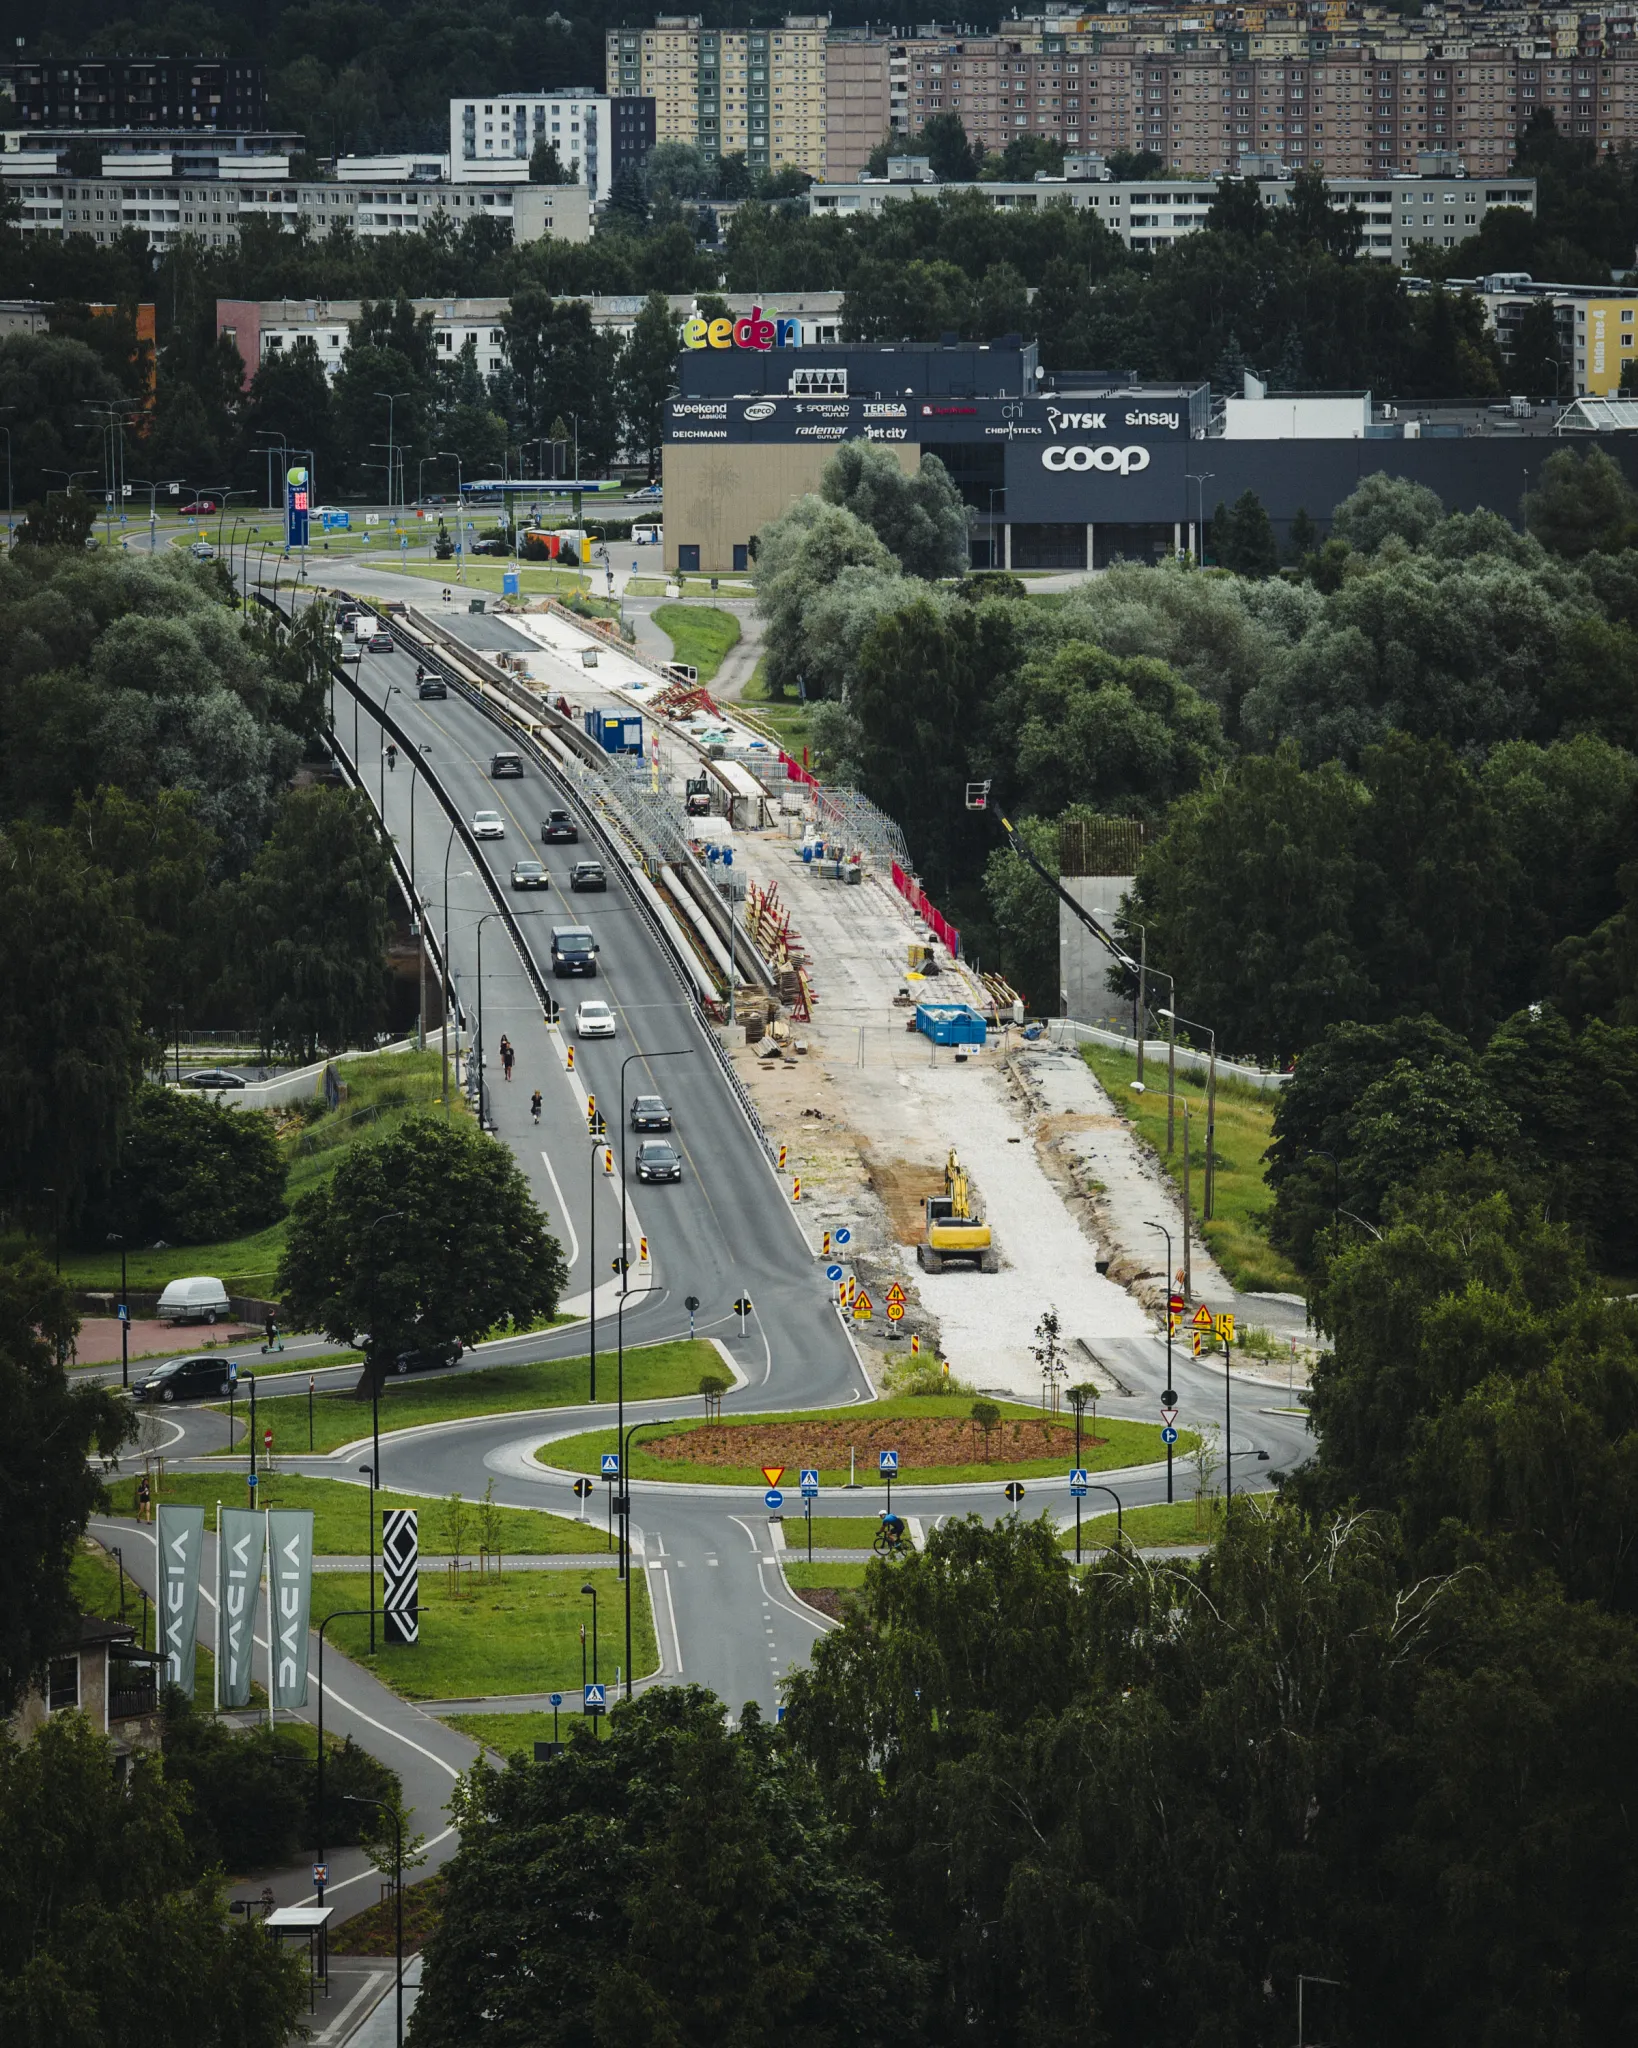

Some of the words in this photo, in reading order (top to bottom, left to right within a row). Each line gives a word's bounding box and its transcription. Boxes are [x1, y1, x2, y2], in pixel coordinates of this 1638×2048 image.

[683, 305, 802, 350] eeden
[673, 403, 727, 413] Weekend
[806, 404, 849, 412] SPORTLAND
[863, 403, 907, 412] TERESA
[1002, 402, 1023, 418] chi
[1060, 413, 1107, 429] JYSK
[1125, 409, 1179, 429] sinsay
[672, 430, 727, 438] DEICHMANN
[795, 425, 849, 434] rademar
[868, 427, 884, 439] pet
[886, 427, 907, 439] city
[1042, 446, 1150, 475] coop
